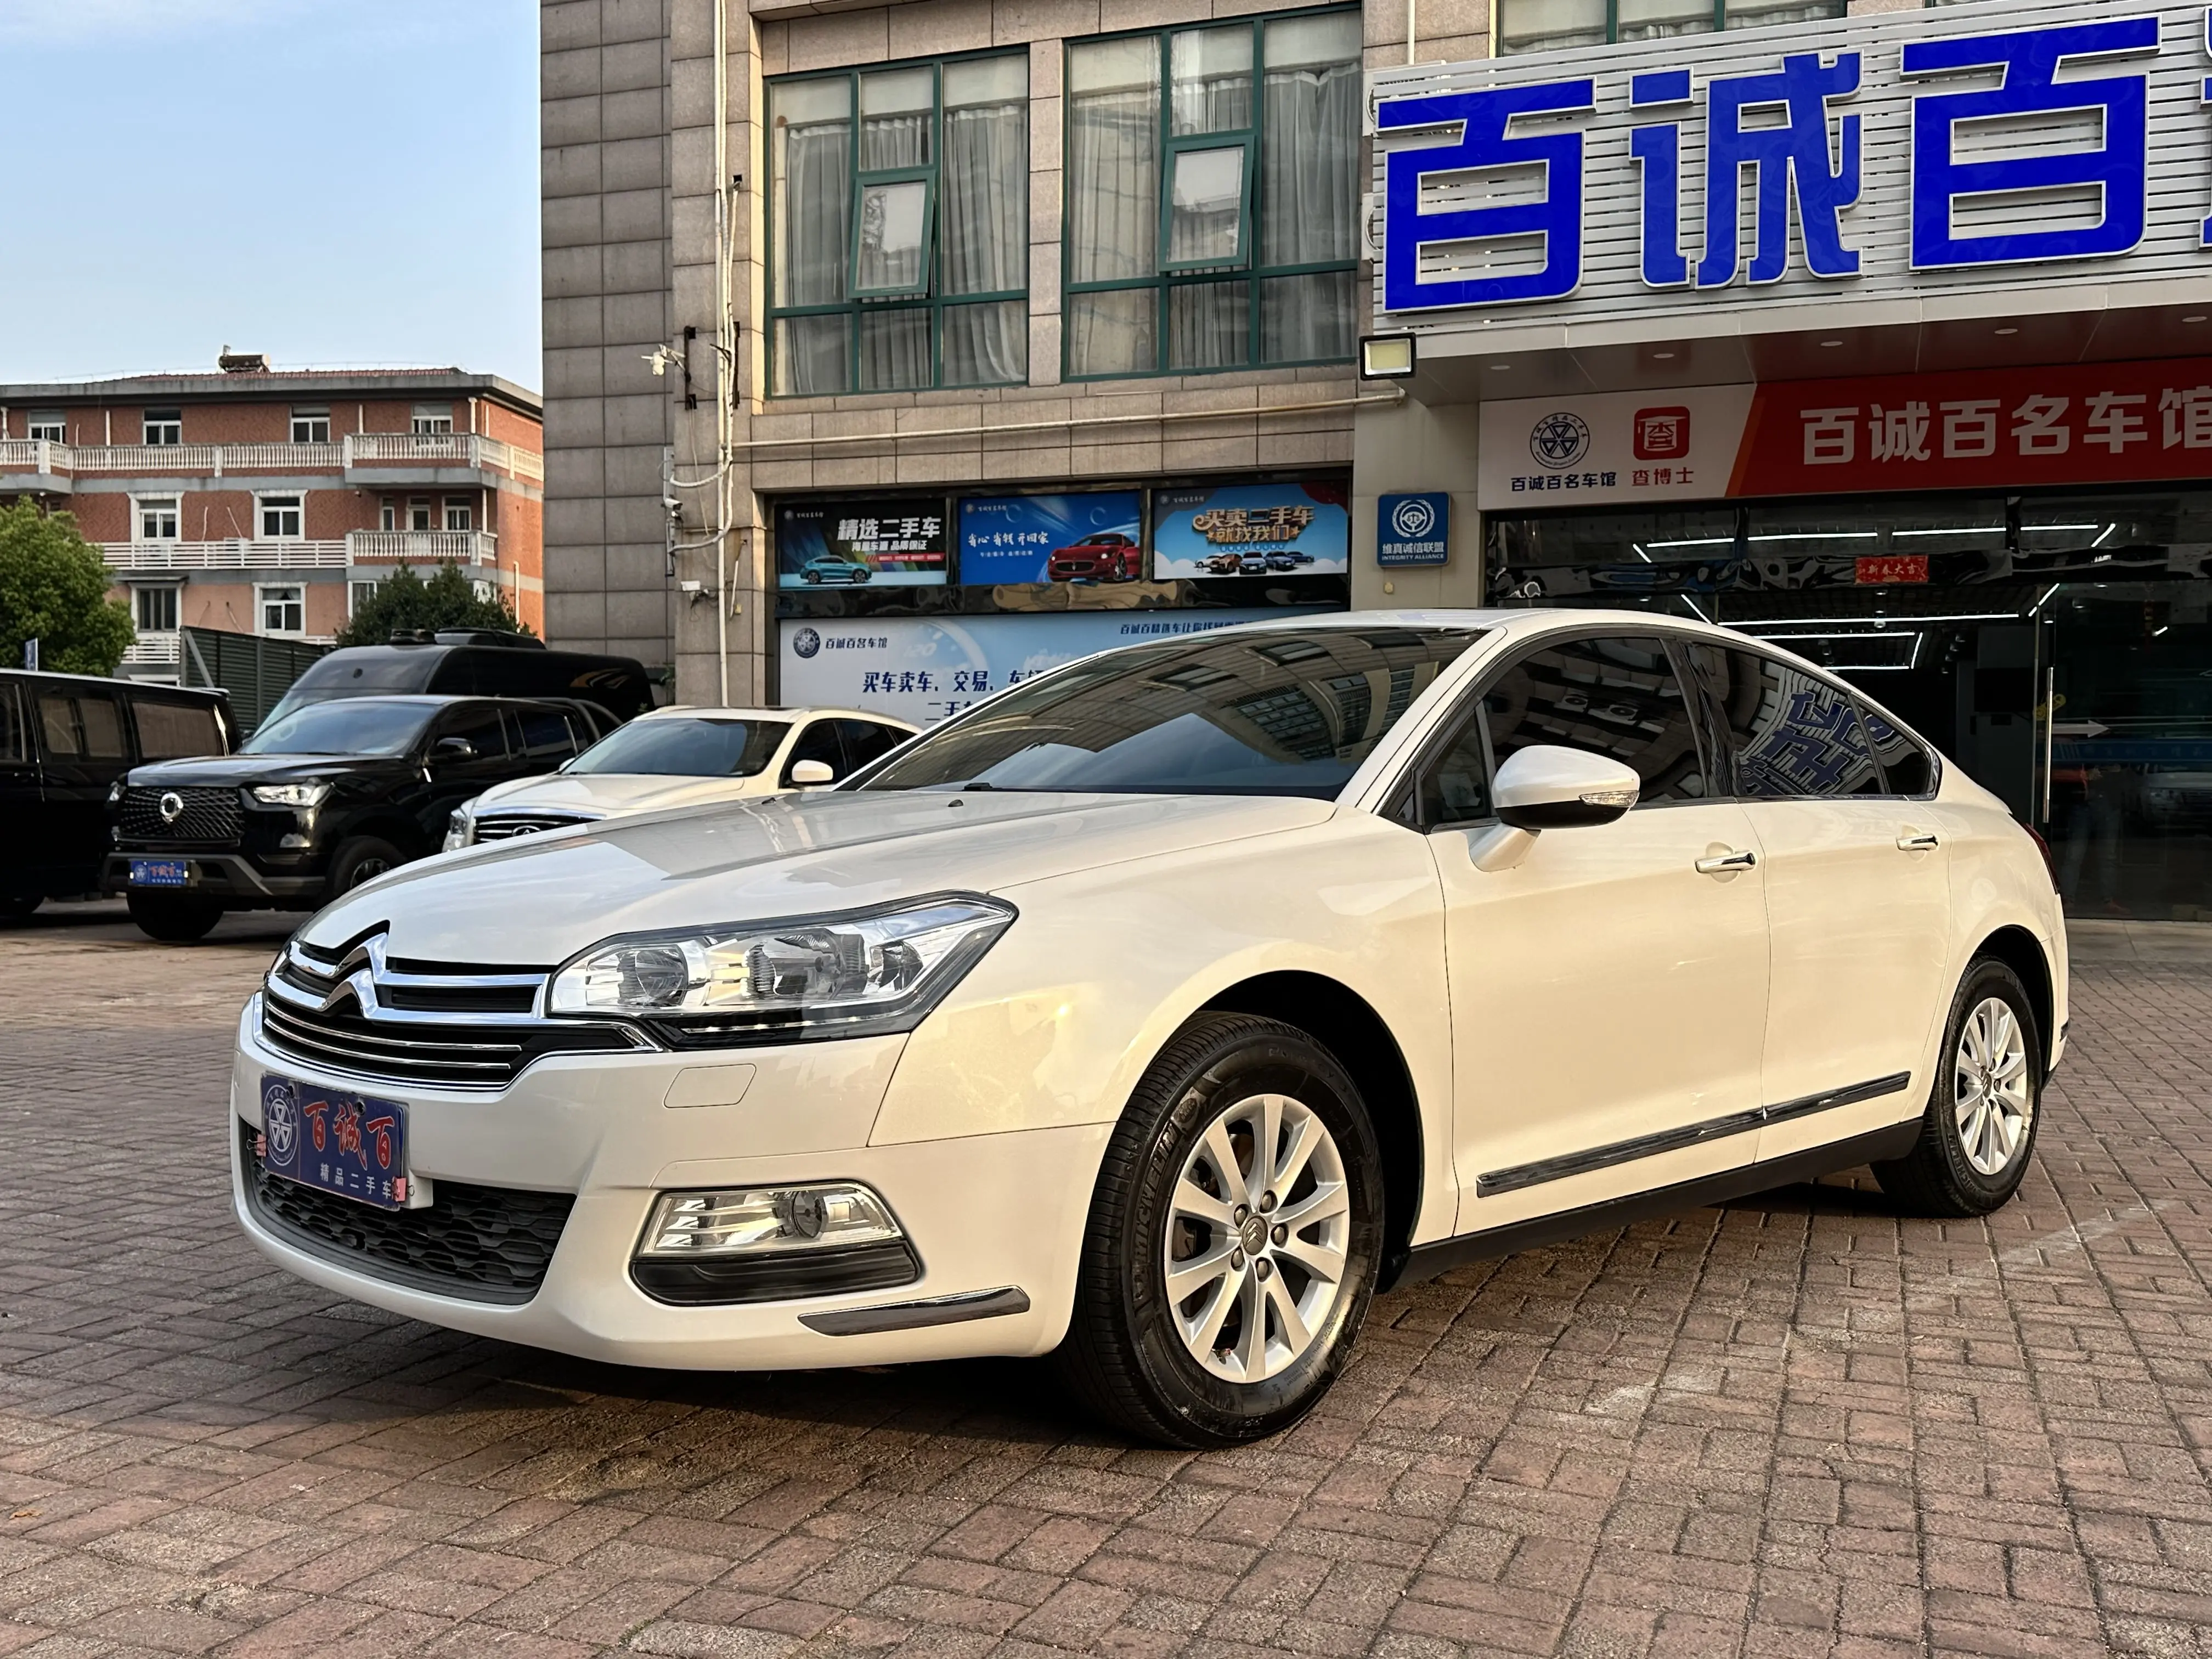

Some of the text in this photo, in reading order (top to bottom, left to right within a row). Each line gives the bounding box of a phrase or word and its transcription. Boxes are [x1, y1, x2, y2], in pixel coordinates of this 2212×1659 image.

[1376, 7, 2212, 314] 百诚百
[1800, 386, 2212, 465] 百诚百名车馆
[1510, 471, 1617, 492] 百诚百名车馆
[1632, 467, 1694, 487] 查博士
[837, 517, 941, 541] 精选二手车
[1193, 505, 1315, 531] 买卖二手车
[1216, 524, 1290, 543] 就找我们
[1382, 541, 1444, 555] 维真诚信联盟
[1867, 563, 1917, 575] 新春大吉
[826, 637, 888, 649] 百诚百名车馆
[320, 1162, 392, 1200] 精品二手车
[1134, 1122, 1178, 1263] MICHELIN
